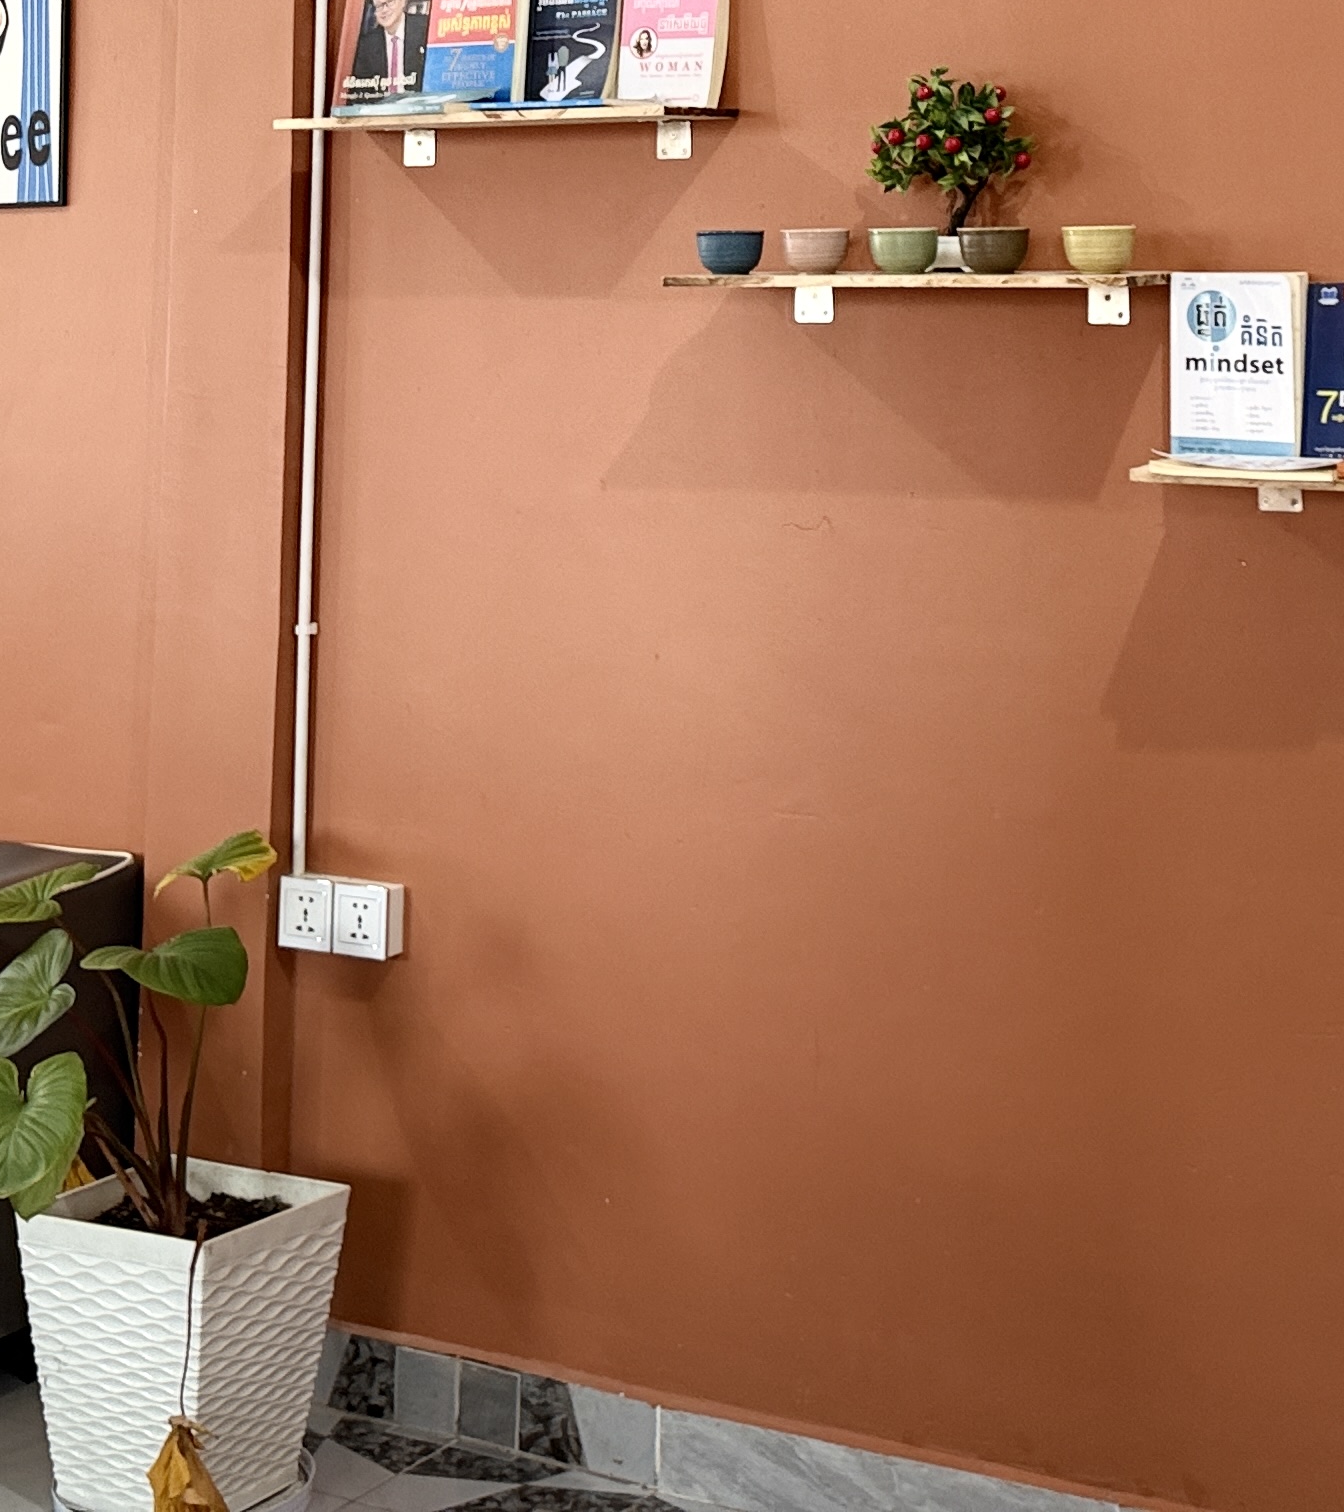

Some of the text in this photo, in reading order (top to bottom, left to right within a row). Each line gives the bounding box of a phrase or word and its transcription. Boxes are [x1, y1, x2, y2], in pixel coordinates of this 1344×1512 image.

[639, 60, 704, 73] WOMAN
[1185, 345, 1284, 375] mindset
[1316, 389, 1339, 424] 7
